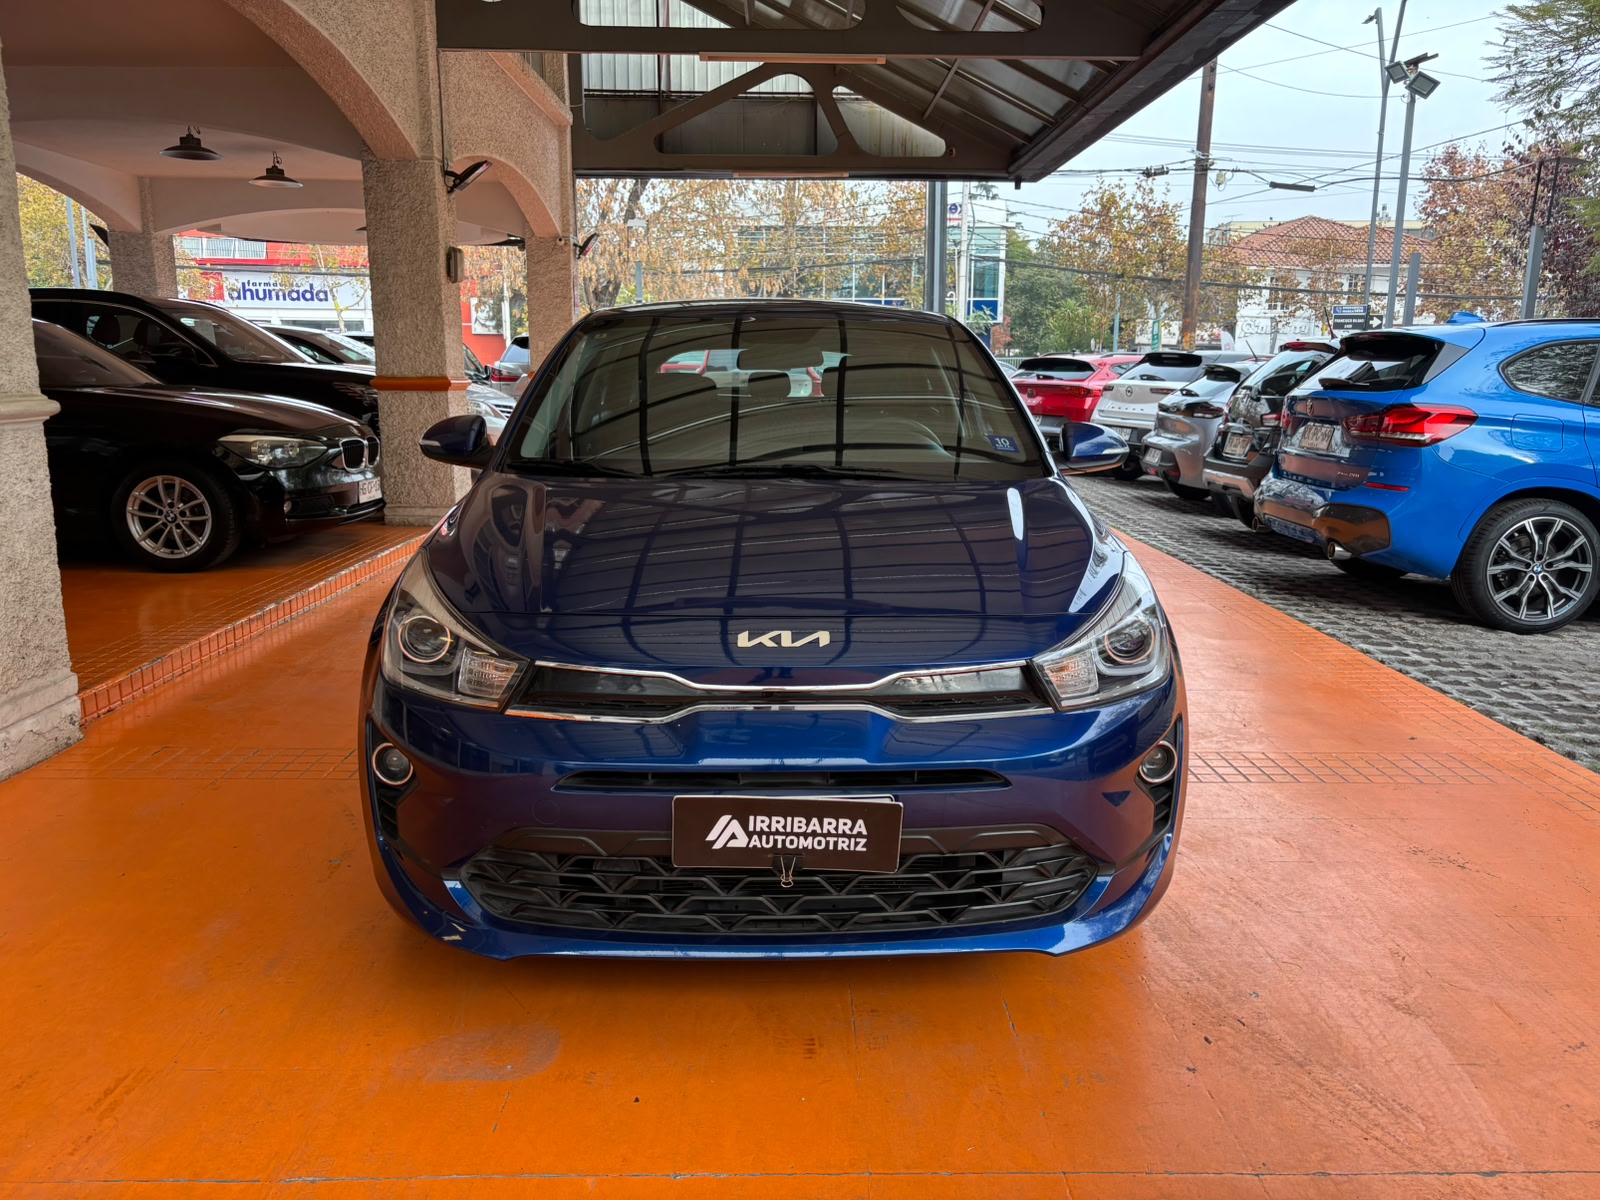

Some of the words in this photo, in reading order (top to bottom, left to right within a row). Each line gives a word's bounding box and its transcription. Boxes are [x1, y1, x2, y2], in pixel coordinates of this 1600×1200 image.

[228, 282, 329, 302] ahumada
[737, 630, 831, 648] KIA
[748, 815, 868, 835] IRRIBARRA
[748, 835, 868, 851] AUTOMOTRIZ
